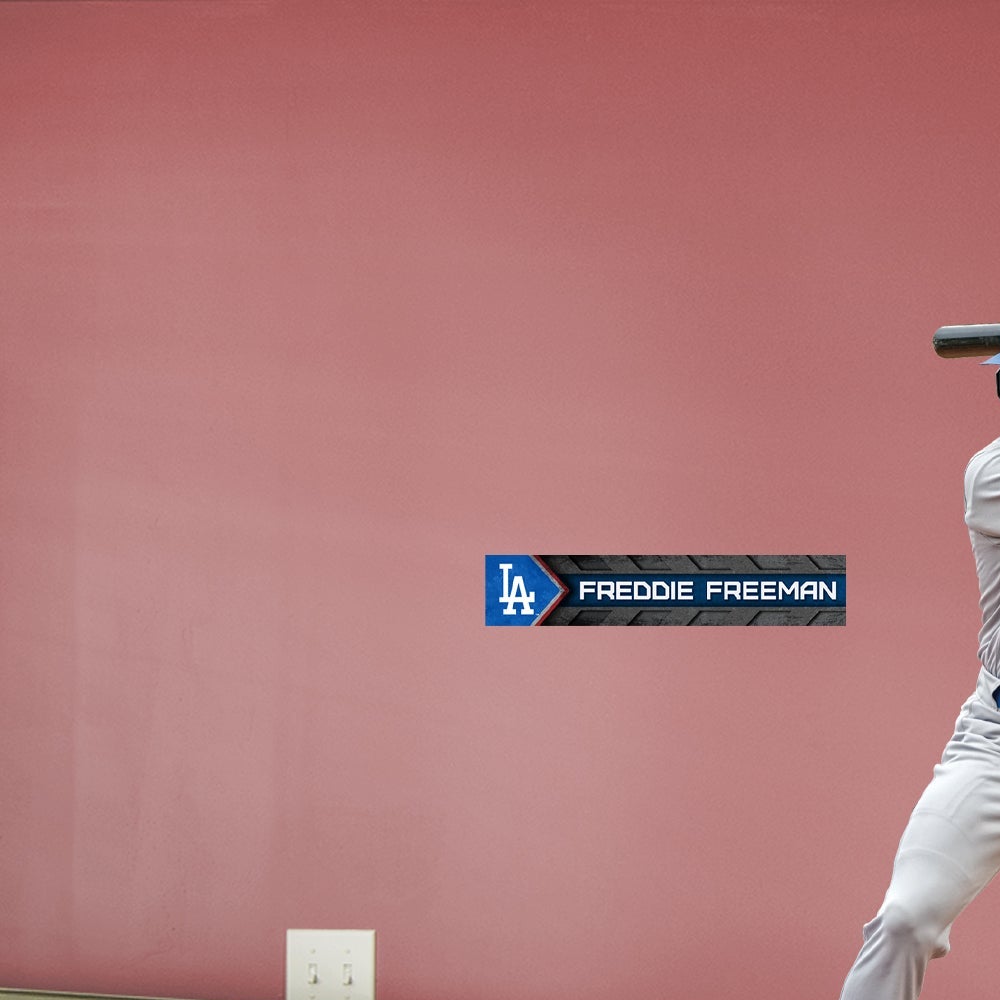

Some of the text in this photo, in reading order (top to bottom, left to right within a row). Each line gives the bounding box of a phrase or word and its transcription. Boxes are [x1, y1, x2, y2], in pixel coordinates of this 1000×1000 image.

[499, 564, 536, 616] LA
[579, 581, 837, 600] FREDDIE FREEMAN
